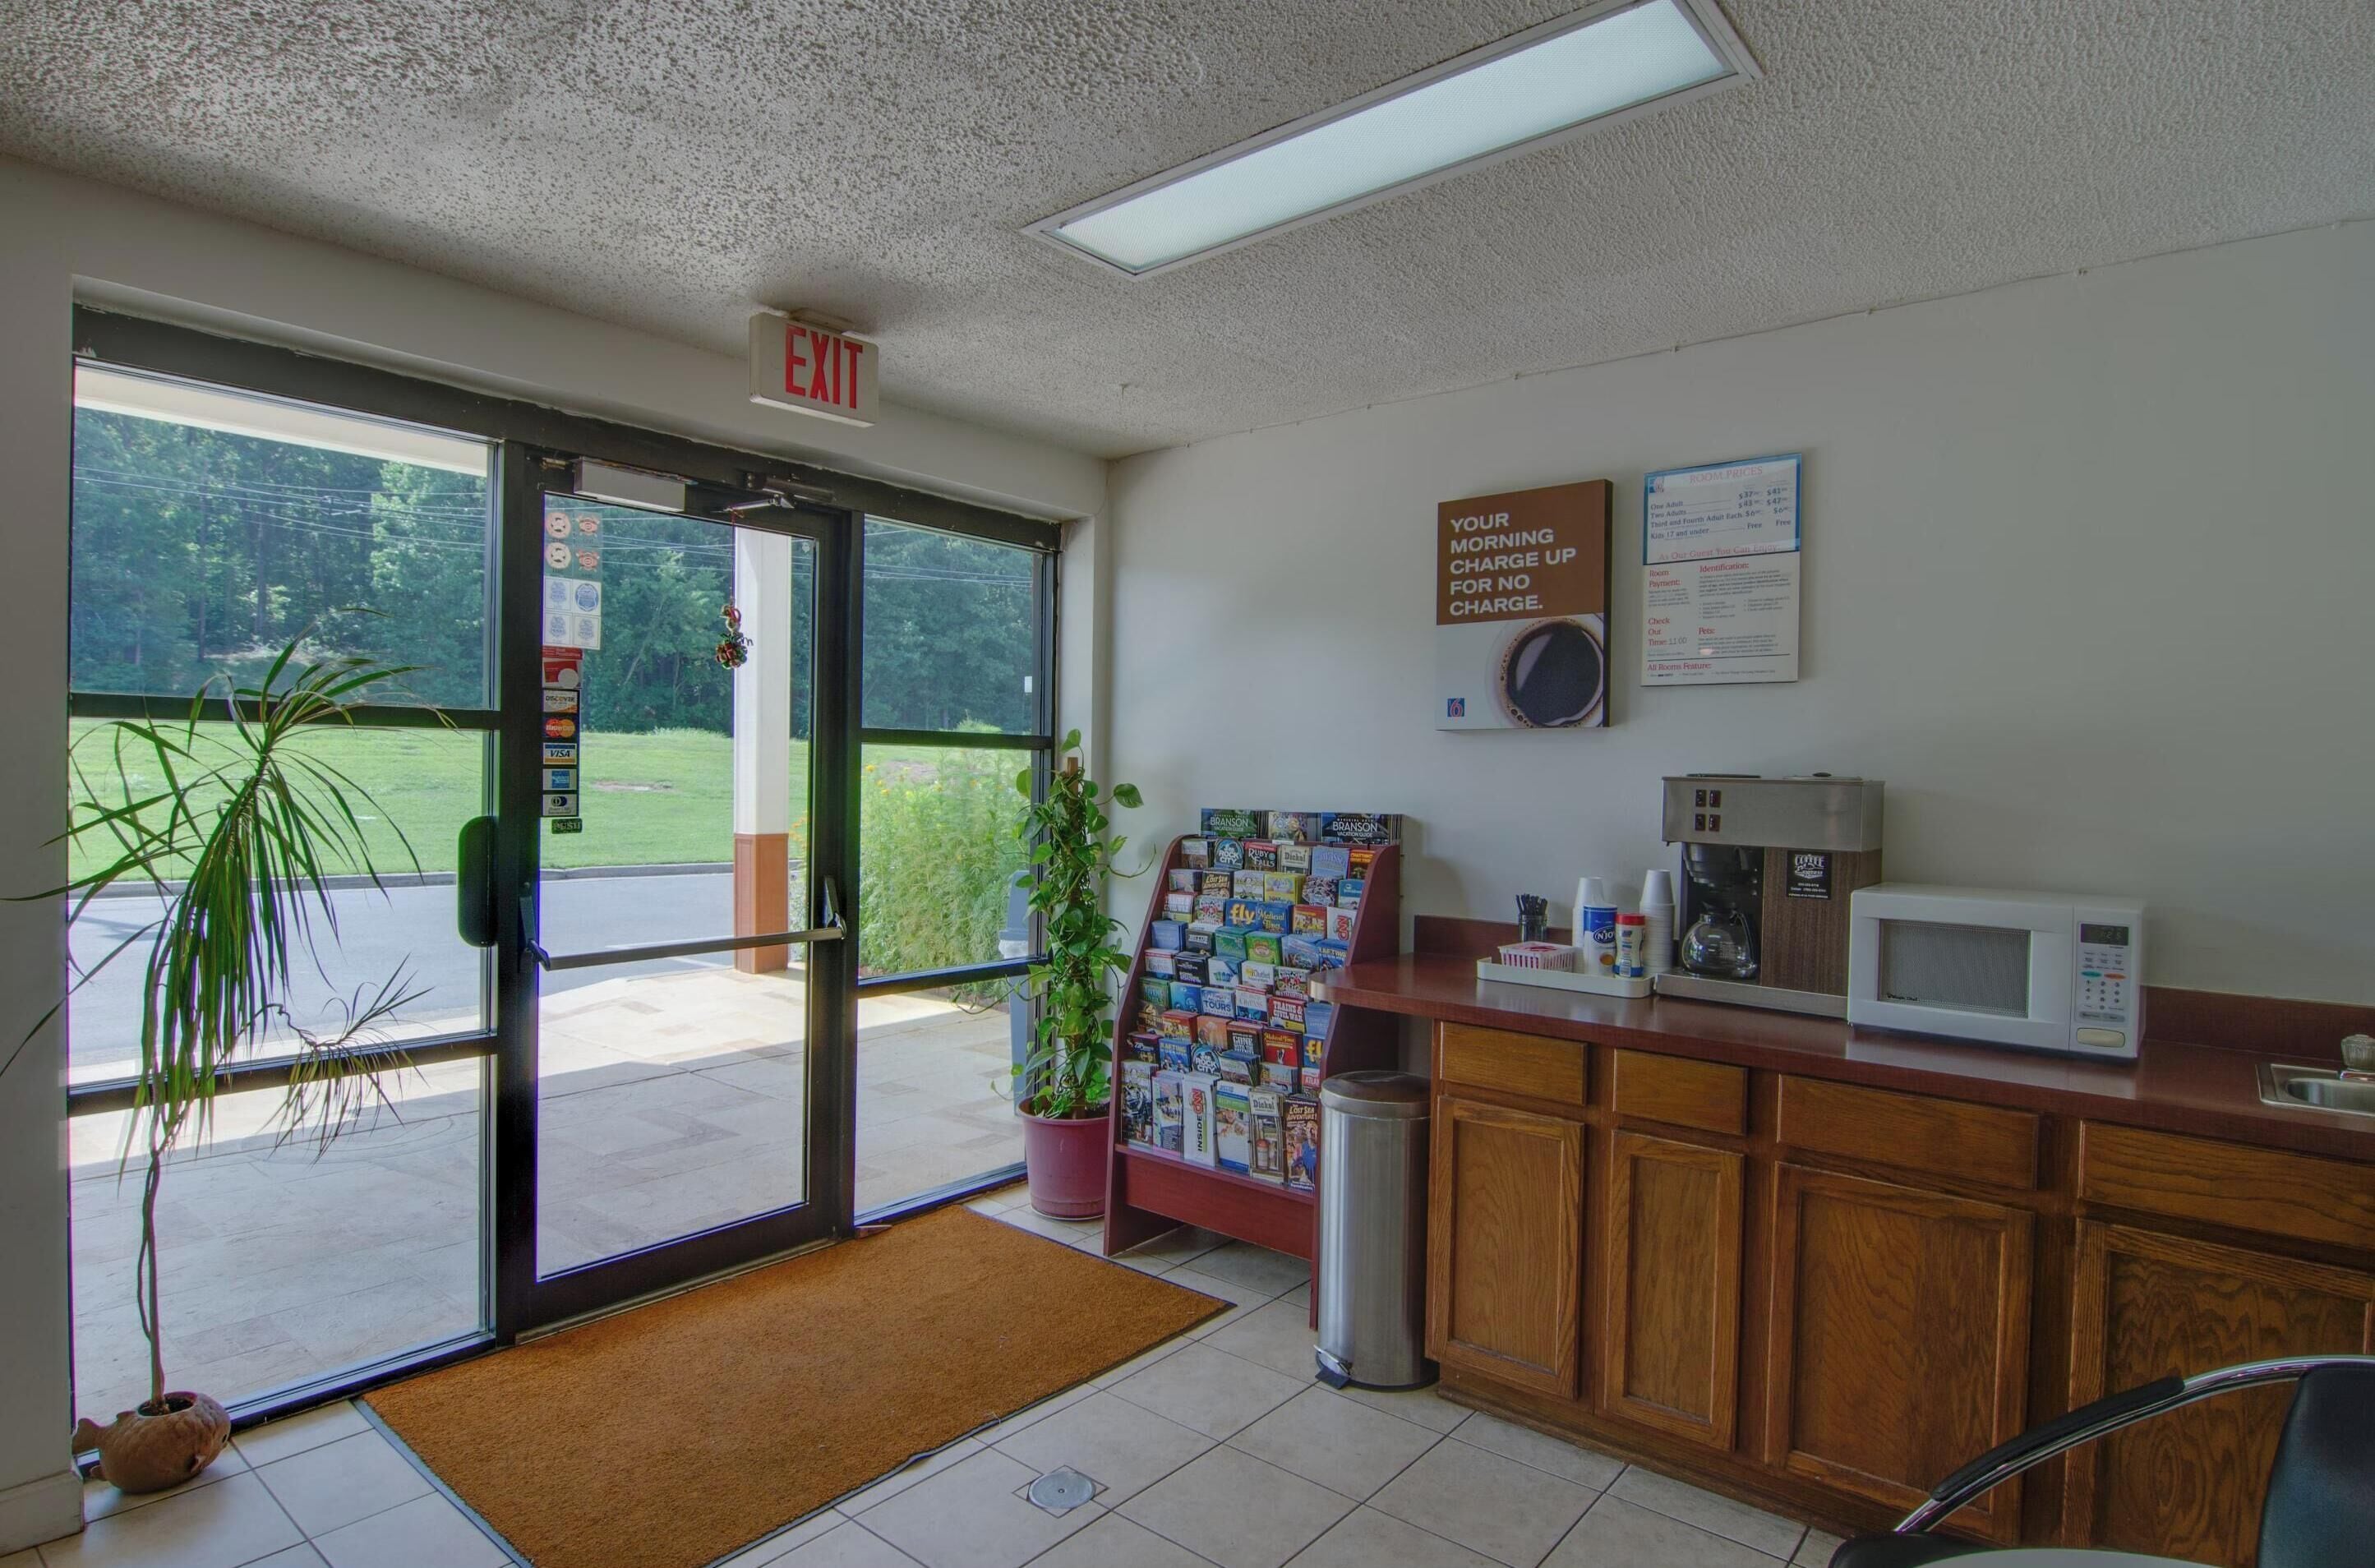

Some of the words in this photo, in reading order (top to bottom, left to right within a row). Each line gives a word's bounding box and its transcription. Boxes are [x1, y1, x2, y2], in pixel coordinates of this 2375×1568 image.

[786, 324, 863, 409] EXIT
[1689, 469, 1724, 484] ROOM
[1727, 466, 1763, 481] PRICES
[1666, 500, 1684, 509] Adult
[1650, 511, 1665, 519] Two
[1666, 509, 1687, 518] Adults
[1651, 519, 1668, 528] Third
[1669, 518, 1681, 527] and
[1683, 515, 1704, 525] Fourth
[1706, 513, 1725, 523] Adult
[1450, 512, 1510, 533] YOUR
[1651, 532, 1665, 541] Kids
[1667, 530, 1675, 538] 17
[1676, 528, 1688, 537] and
[1689, 526, 1710, 536] under
[1747, 522, 1763, 530] Free
[1775, 519, 1792, 527] Free
[1450, 528, 1555, 554] MORNING
[1672, 550, 1688, 560] Our
[1690, 548, 1714, 559] Guest
[1715, 546, 1732, 556] You
[1450, 551, 1539, 574] CHARGE
[1545, 547, 1577, 565] UP
[1699, 562, 1750, 574] Identification:
[1450, 578, 1492, 595] FOR
[1498, 574, 1530, 592] NO
[1450, 595, 1543, 616] CHARGE.
[1648, 617, 1671, 625] Check
[1648, 628, 1661, 636] Out
[1698, 627, 1715, 635] Pets:
[1648, 662, 1658, 671] All
[1658, 662, 1682, 671] Rooms
[1683, 661, 1713, 671] Feature:
[551, 749, 571, 758] VISA
[1210, 816, 1248, 828] BRANSON
[1332, 821, 1377, 832] BRANSON
[1218, 851, 1238, 859] ROCK
[1337, 915, 1349, 941] CNN
[1203, 999, 1231, 1012] TOURS
[1273, 1000, 1294, 1013] TRAINS
[1273, 1009, 1289, 1018] CIVIL
[1306, 1040, 1323, 1063] fl
[1196, 1058, 1215, 1068] ROCK
[1197, 1065, 1215, 1074] CITY
[1192, 1087, 1204, 1114] CNN
